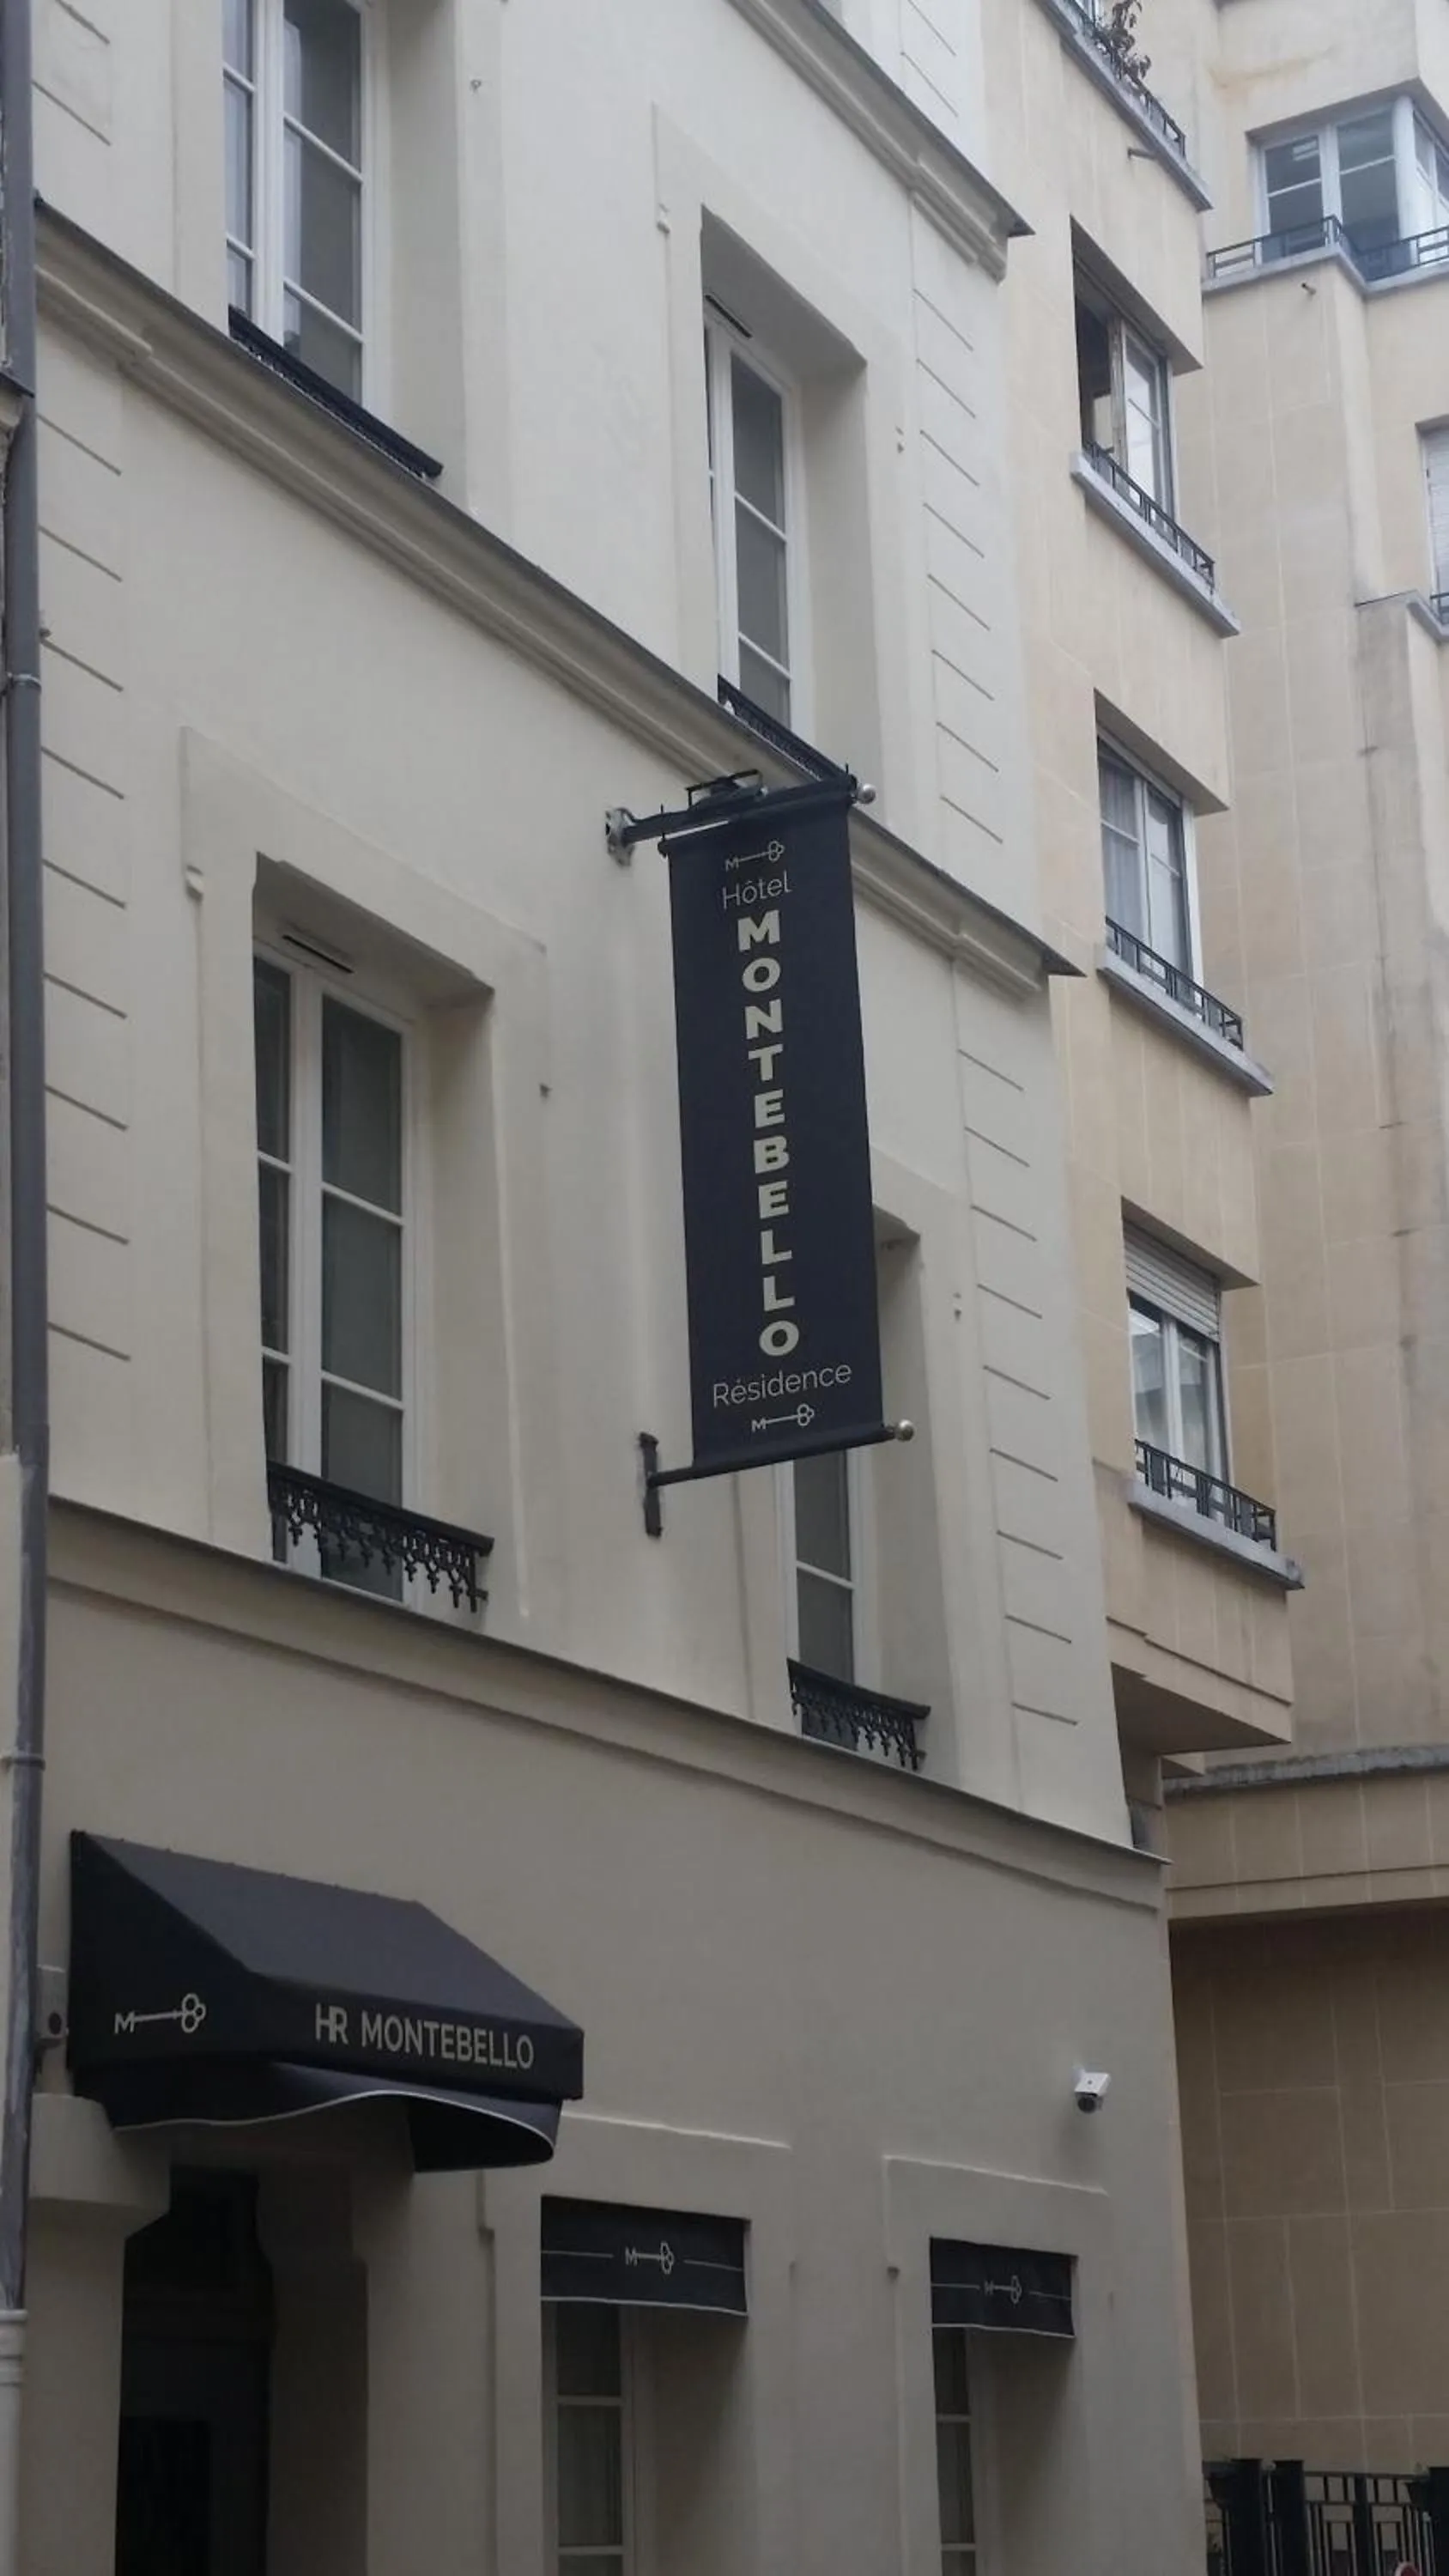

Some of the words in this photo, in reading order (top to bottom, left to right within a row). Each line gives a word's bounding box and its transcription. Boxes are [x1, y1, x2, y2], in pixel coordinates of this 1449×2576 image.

[723, 869, 792, 909] Hôtel
[737, 910, 799, 1356] MONTEBELLO
[713, 1364, 852, 1408] Résidence
[114, 2012, 136, 2034] M
[315, 2003, 348, 2045] HR
[361, 2010, 534, 2069] MONTEBELLO
